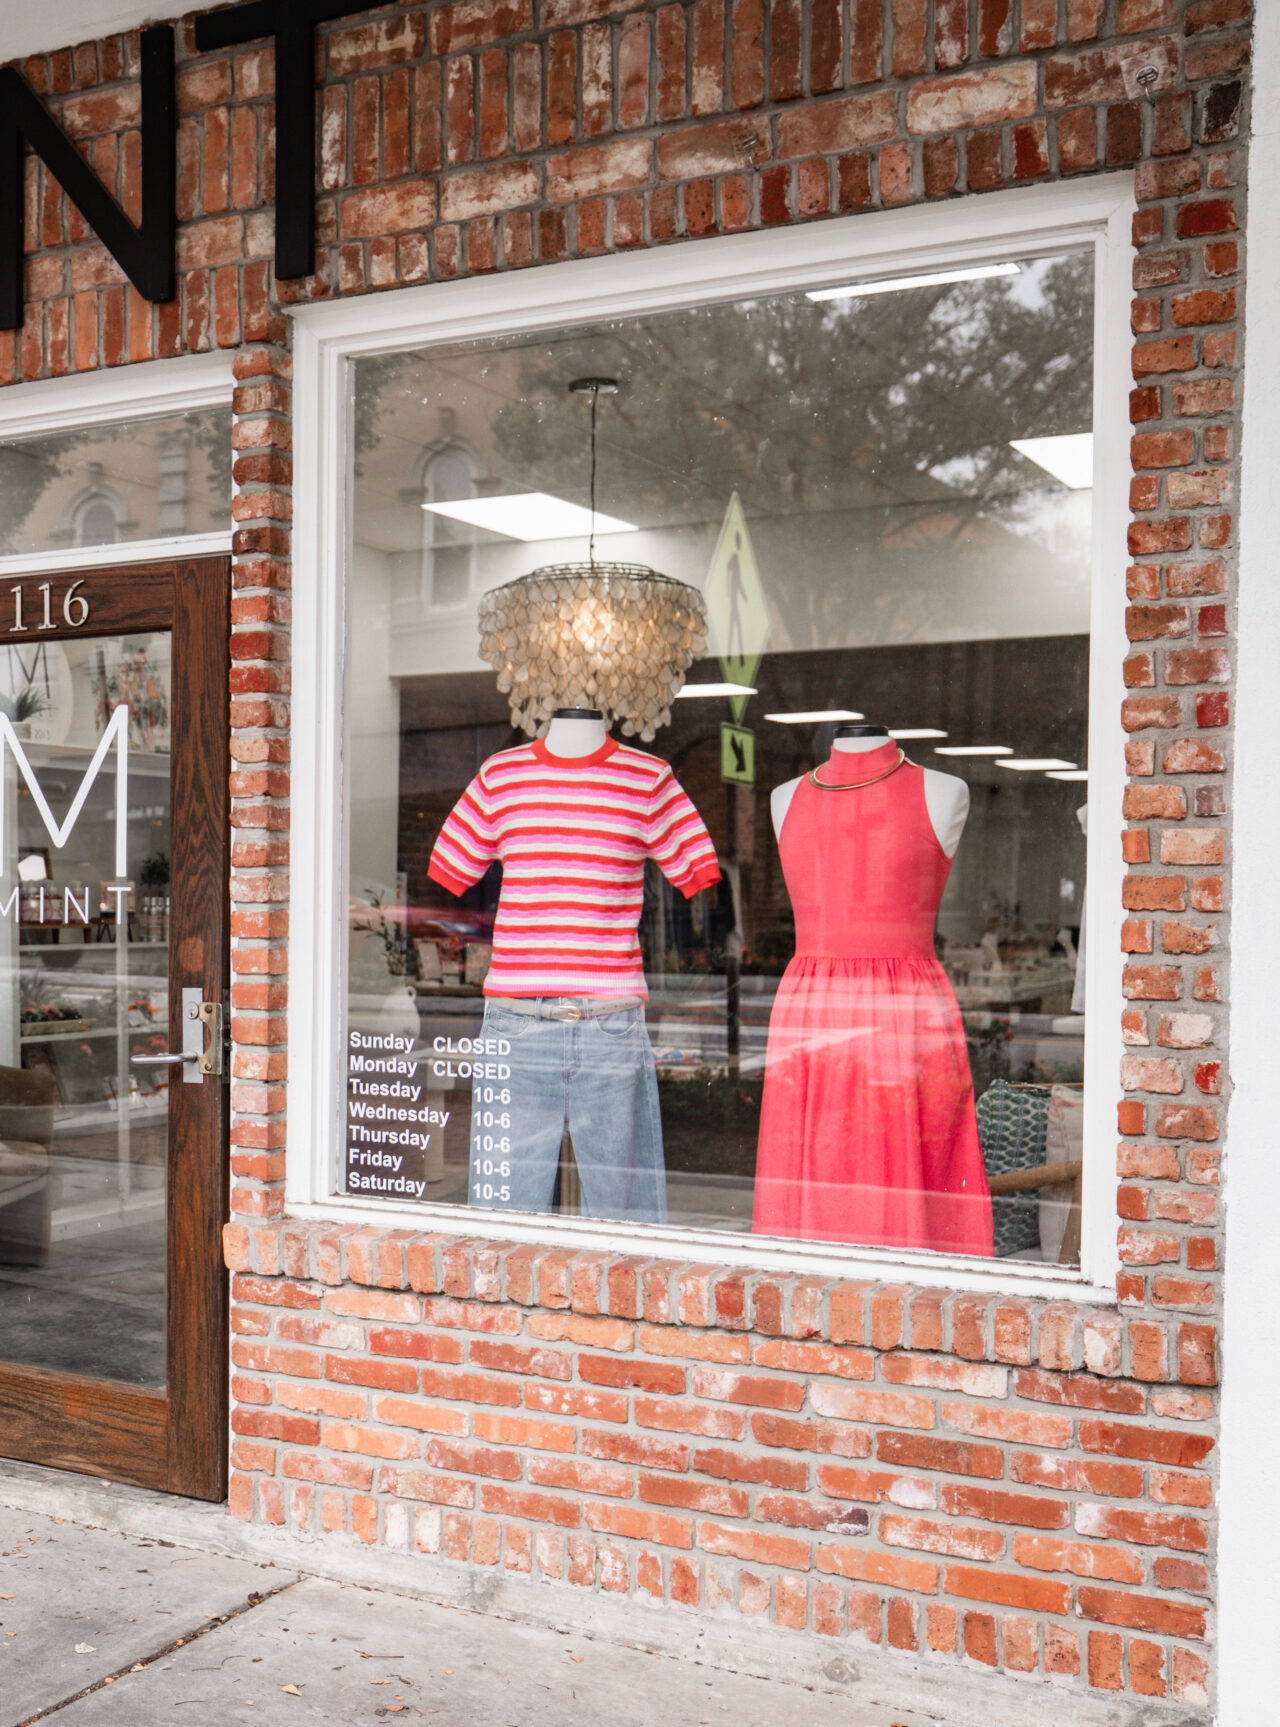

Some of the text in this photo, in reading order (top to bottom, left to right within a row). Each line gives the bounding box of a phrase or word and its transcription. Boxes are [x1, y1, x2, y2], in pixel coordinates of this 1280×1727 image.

[9, 579, 90, 632] 116
[349, 1032, 511, 1056] Sunday CLOSED
[349, 1055, 511, 1080] Monday CLOSED
[349, 1078, 511, 1104] Tuesday 10-6
[349, 1101, 511, 1128] Wednesday 10-6
[349, 1125, 511, 1153] Thursday 10-6
[349, 1148, 511, 1177] Friday 10-6
[348, 1172, 511, 1201] Saturday 10-5
